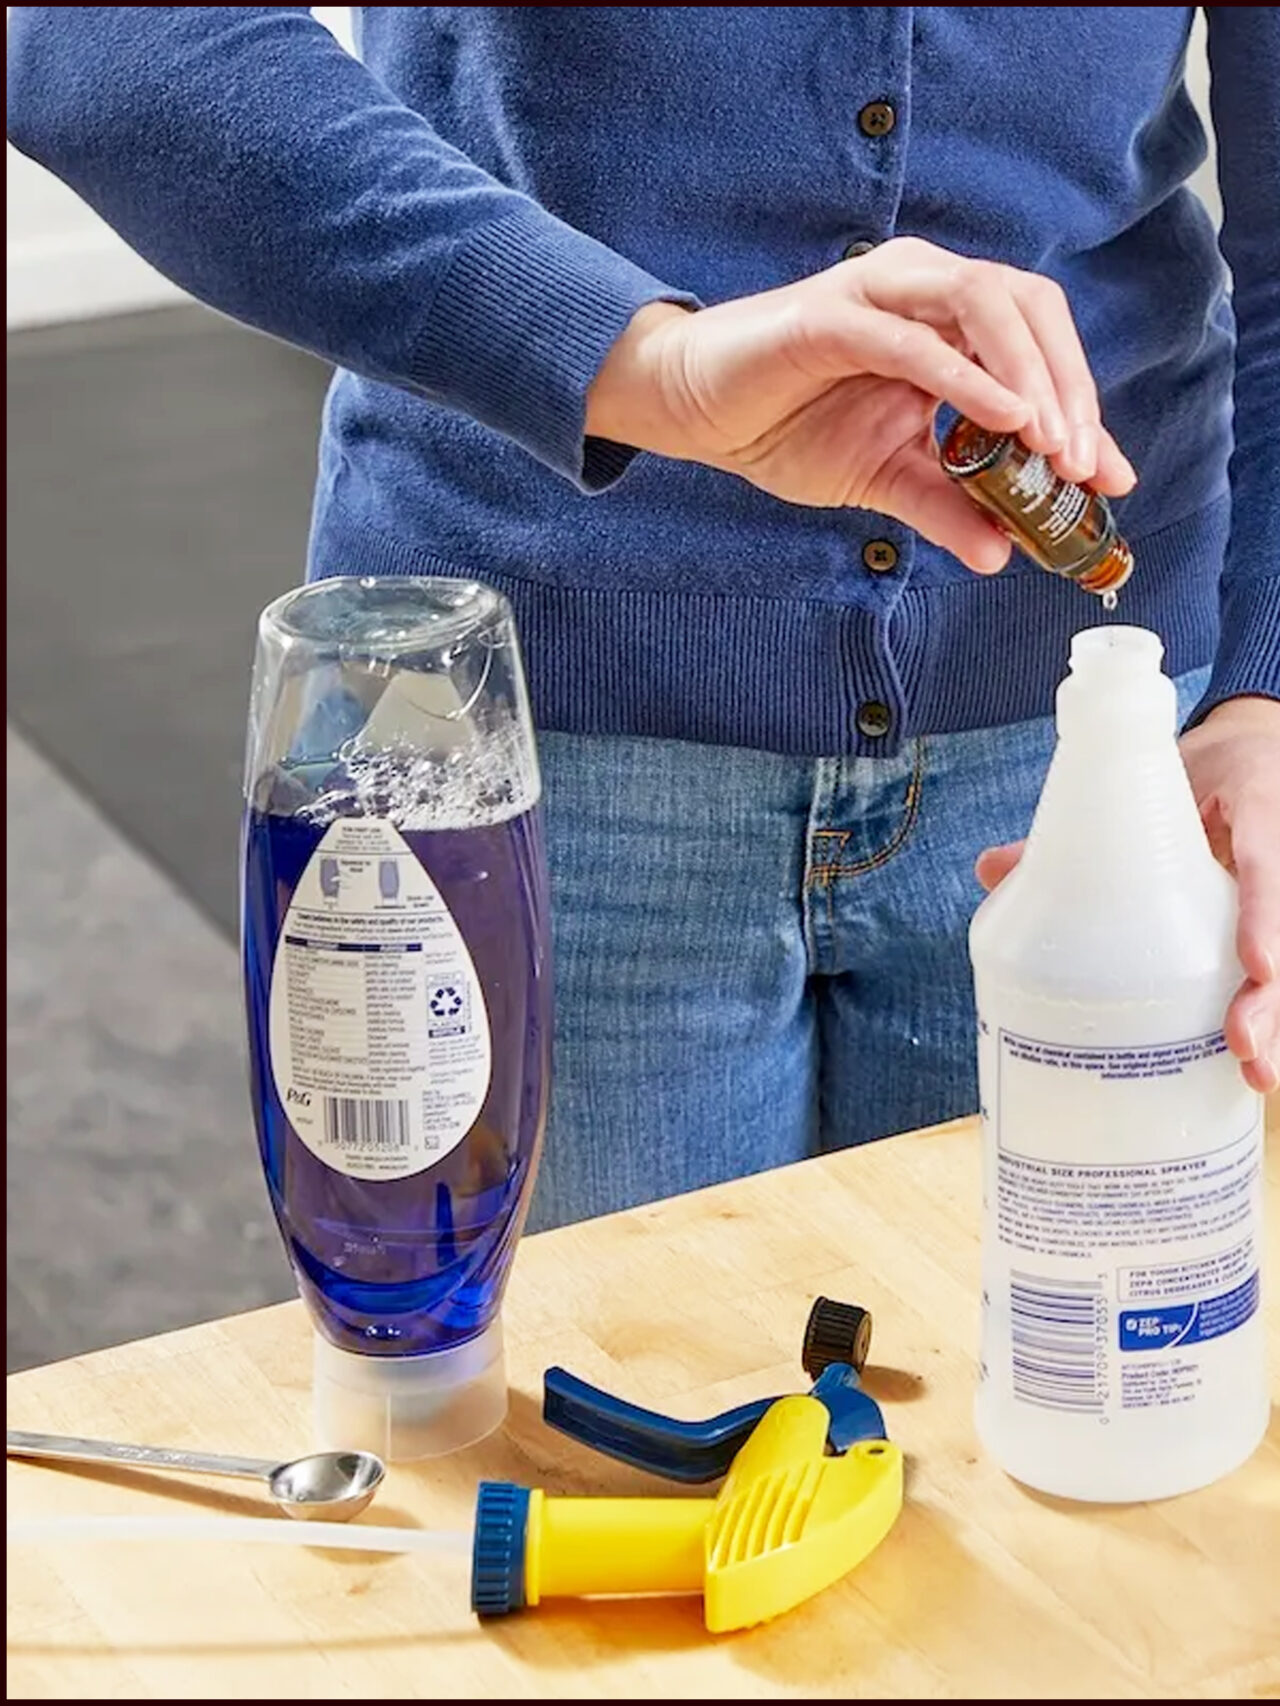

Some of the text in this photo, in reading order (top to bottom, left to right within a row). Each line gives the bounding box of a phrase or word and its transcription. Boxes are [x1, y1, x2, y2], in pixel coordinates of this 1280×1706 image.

[1051, 1168, 1075, 1178] SIZE
[1078, 1168, 1157, 1178] PROFESSIONAL
[1161, 1160, 1207, 1174] SPRAYER
[1129, 1270, 1148, 1278] FOR
[1150, 1266, 1180, 1276] TOUGH
[1181, 1259, 1217, 1273] KITCHEN
[1155, 1268, 1220, 1286] CONCENTRATED
[1129, 1287, 1162, 1297] CITRUS
[1164, 1279, 1213, 1295] DEGREASER
[1137, 1325, 1162, 1337] PRO
